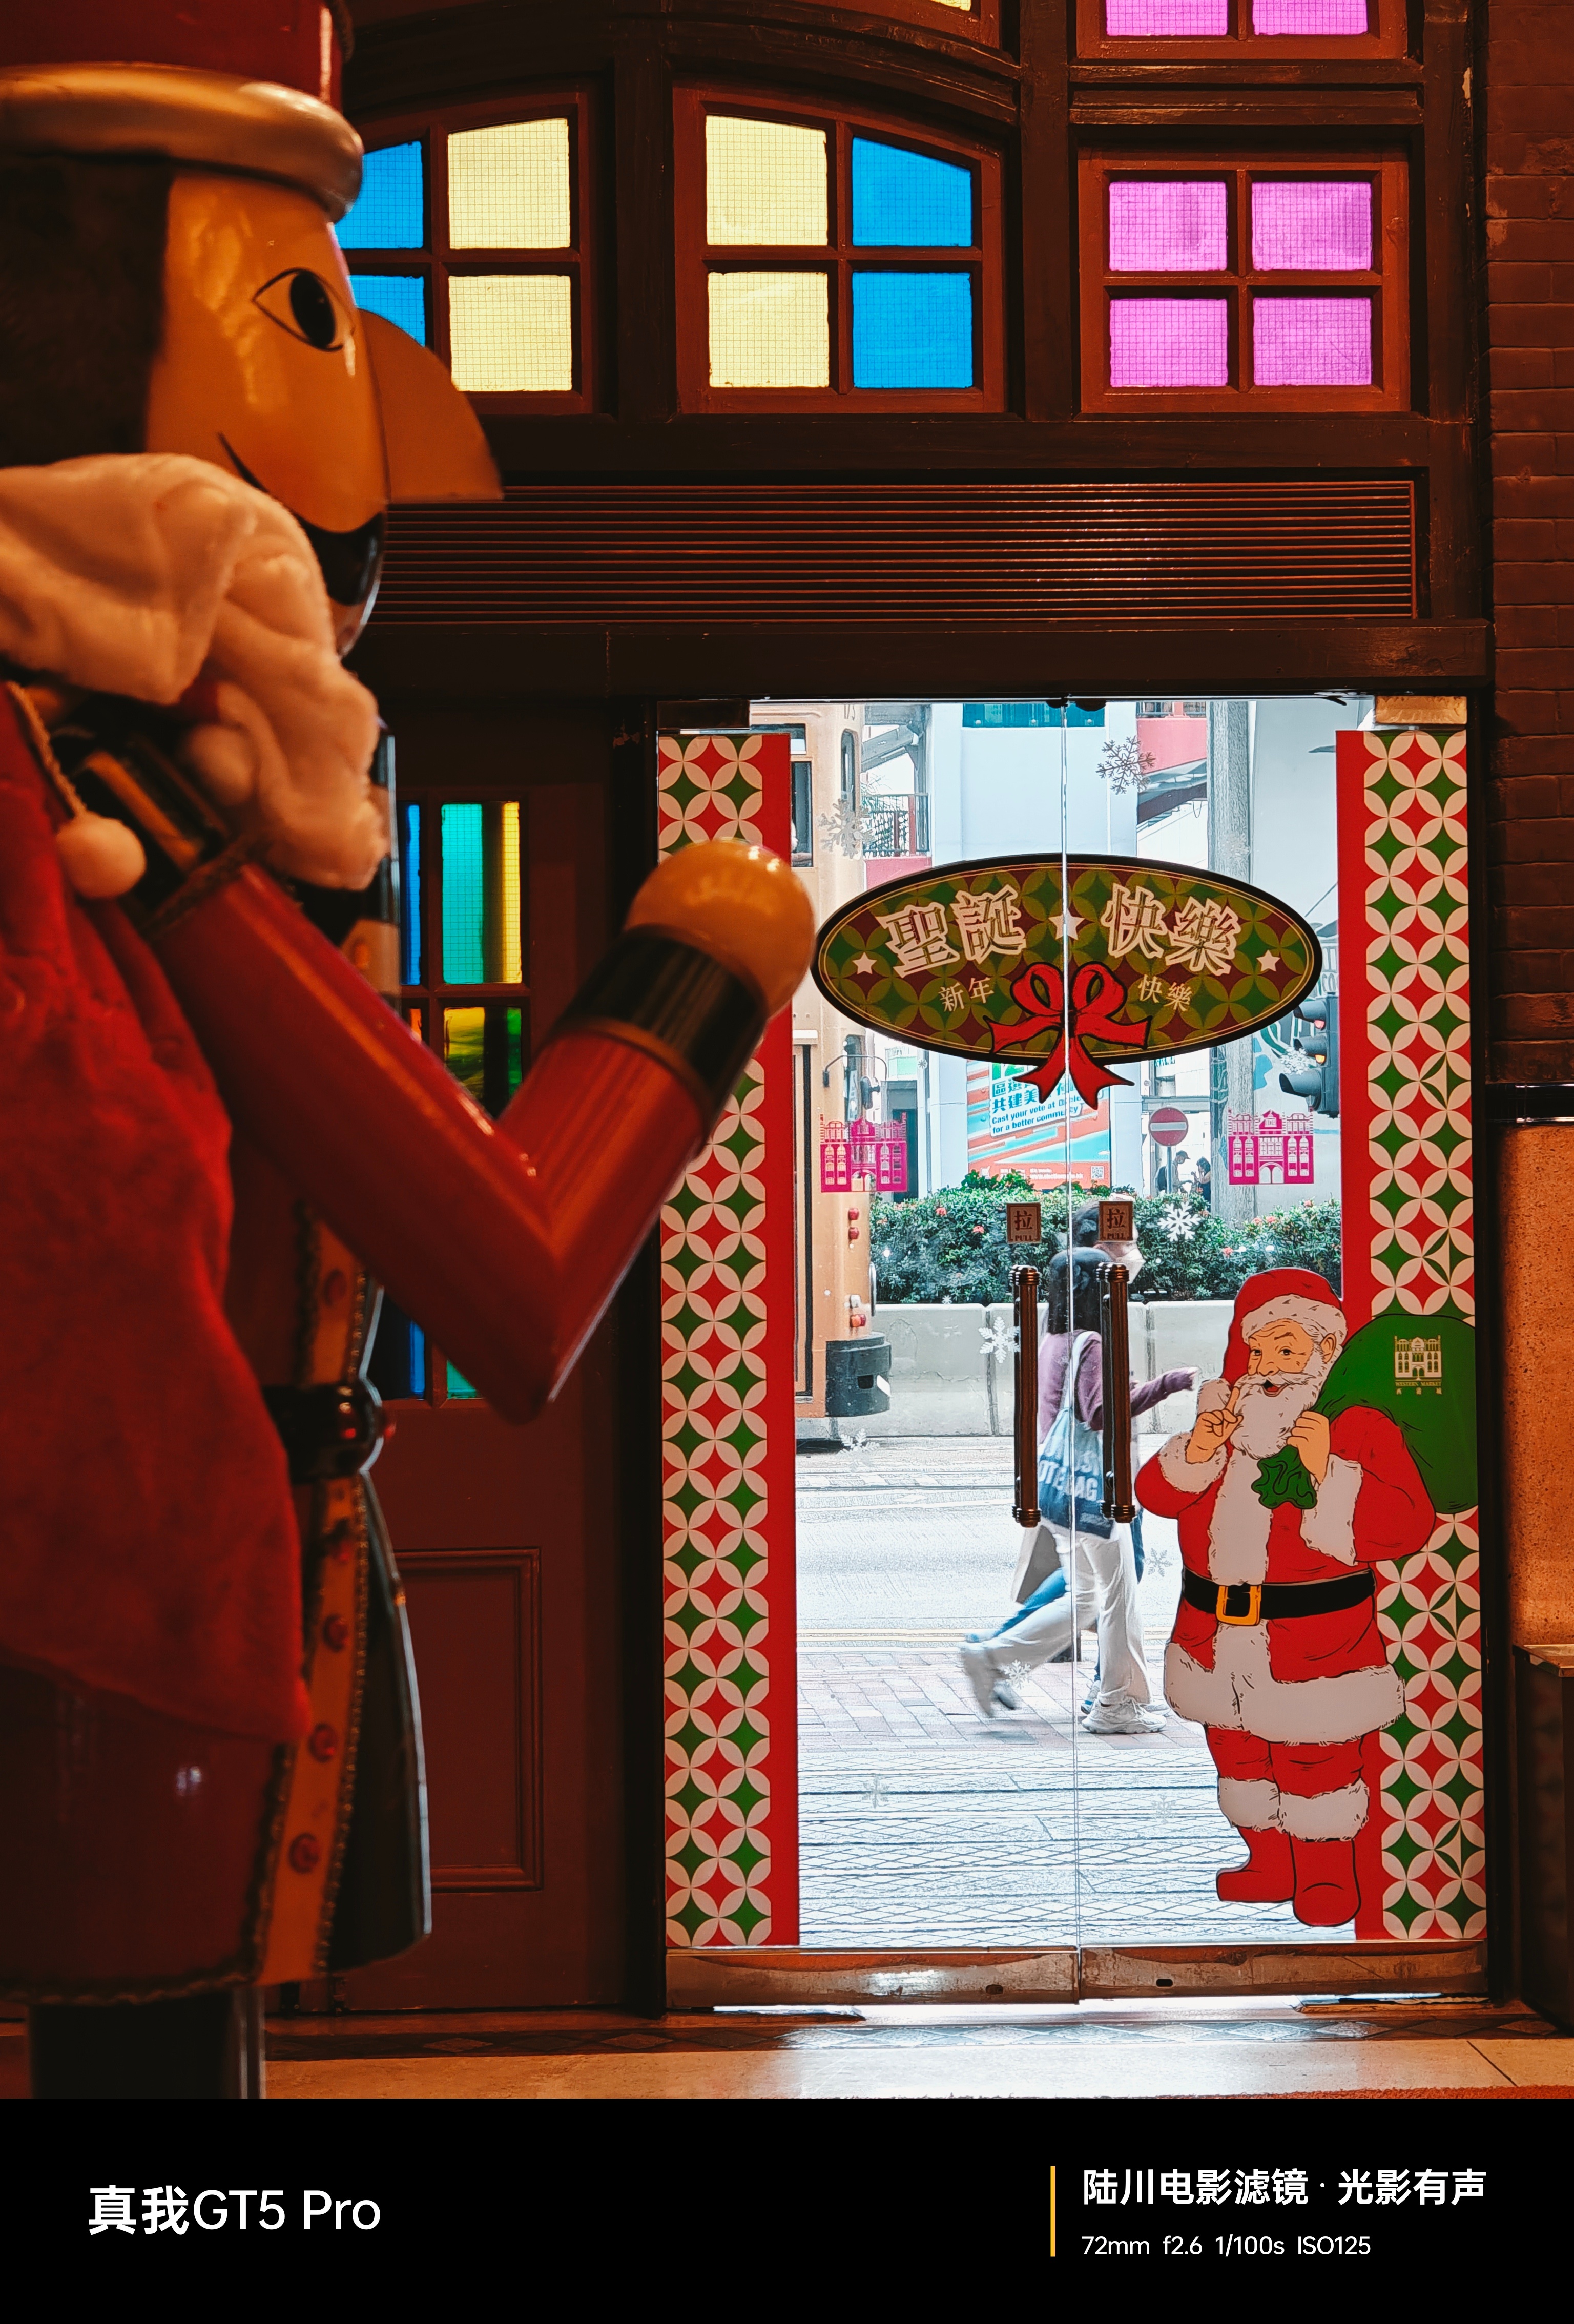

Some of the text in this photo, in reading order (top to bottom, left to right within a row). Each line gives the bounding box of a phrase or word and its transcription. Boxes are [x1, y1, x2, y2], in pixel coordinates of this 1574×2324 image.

[876, 882, 1242, 978] 聖誕 快樂
[938, 974, 1193, 1012] 新年 快樂
[992, 1113, 1009, 1124] Cast
[1010, 1110, 1028, 1121] your
[1029, 1104, 1046, 1114] vote
[1047, 1100, 1055, 1109] at
[992, 1126, 1004, 1134] for
[1012, 1117, 1035, 1129] better
[1013, 1210, 1033, 1231] 拉
[1106, 1208, 1126, 1229] 拉
